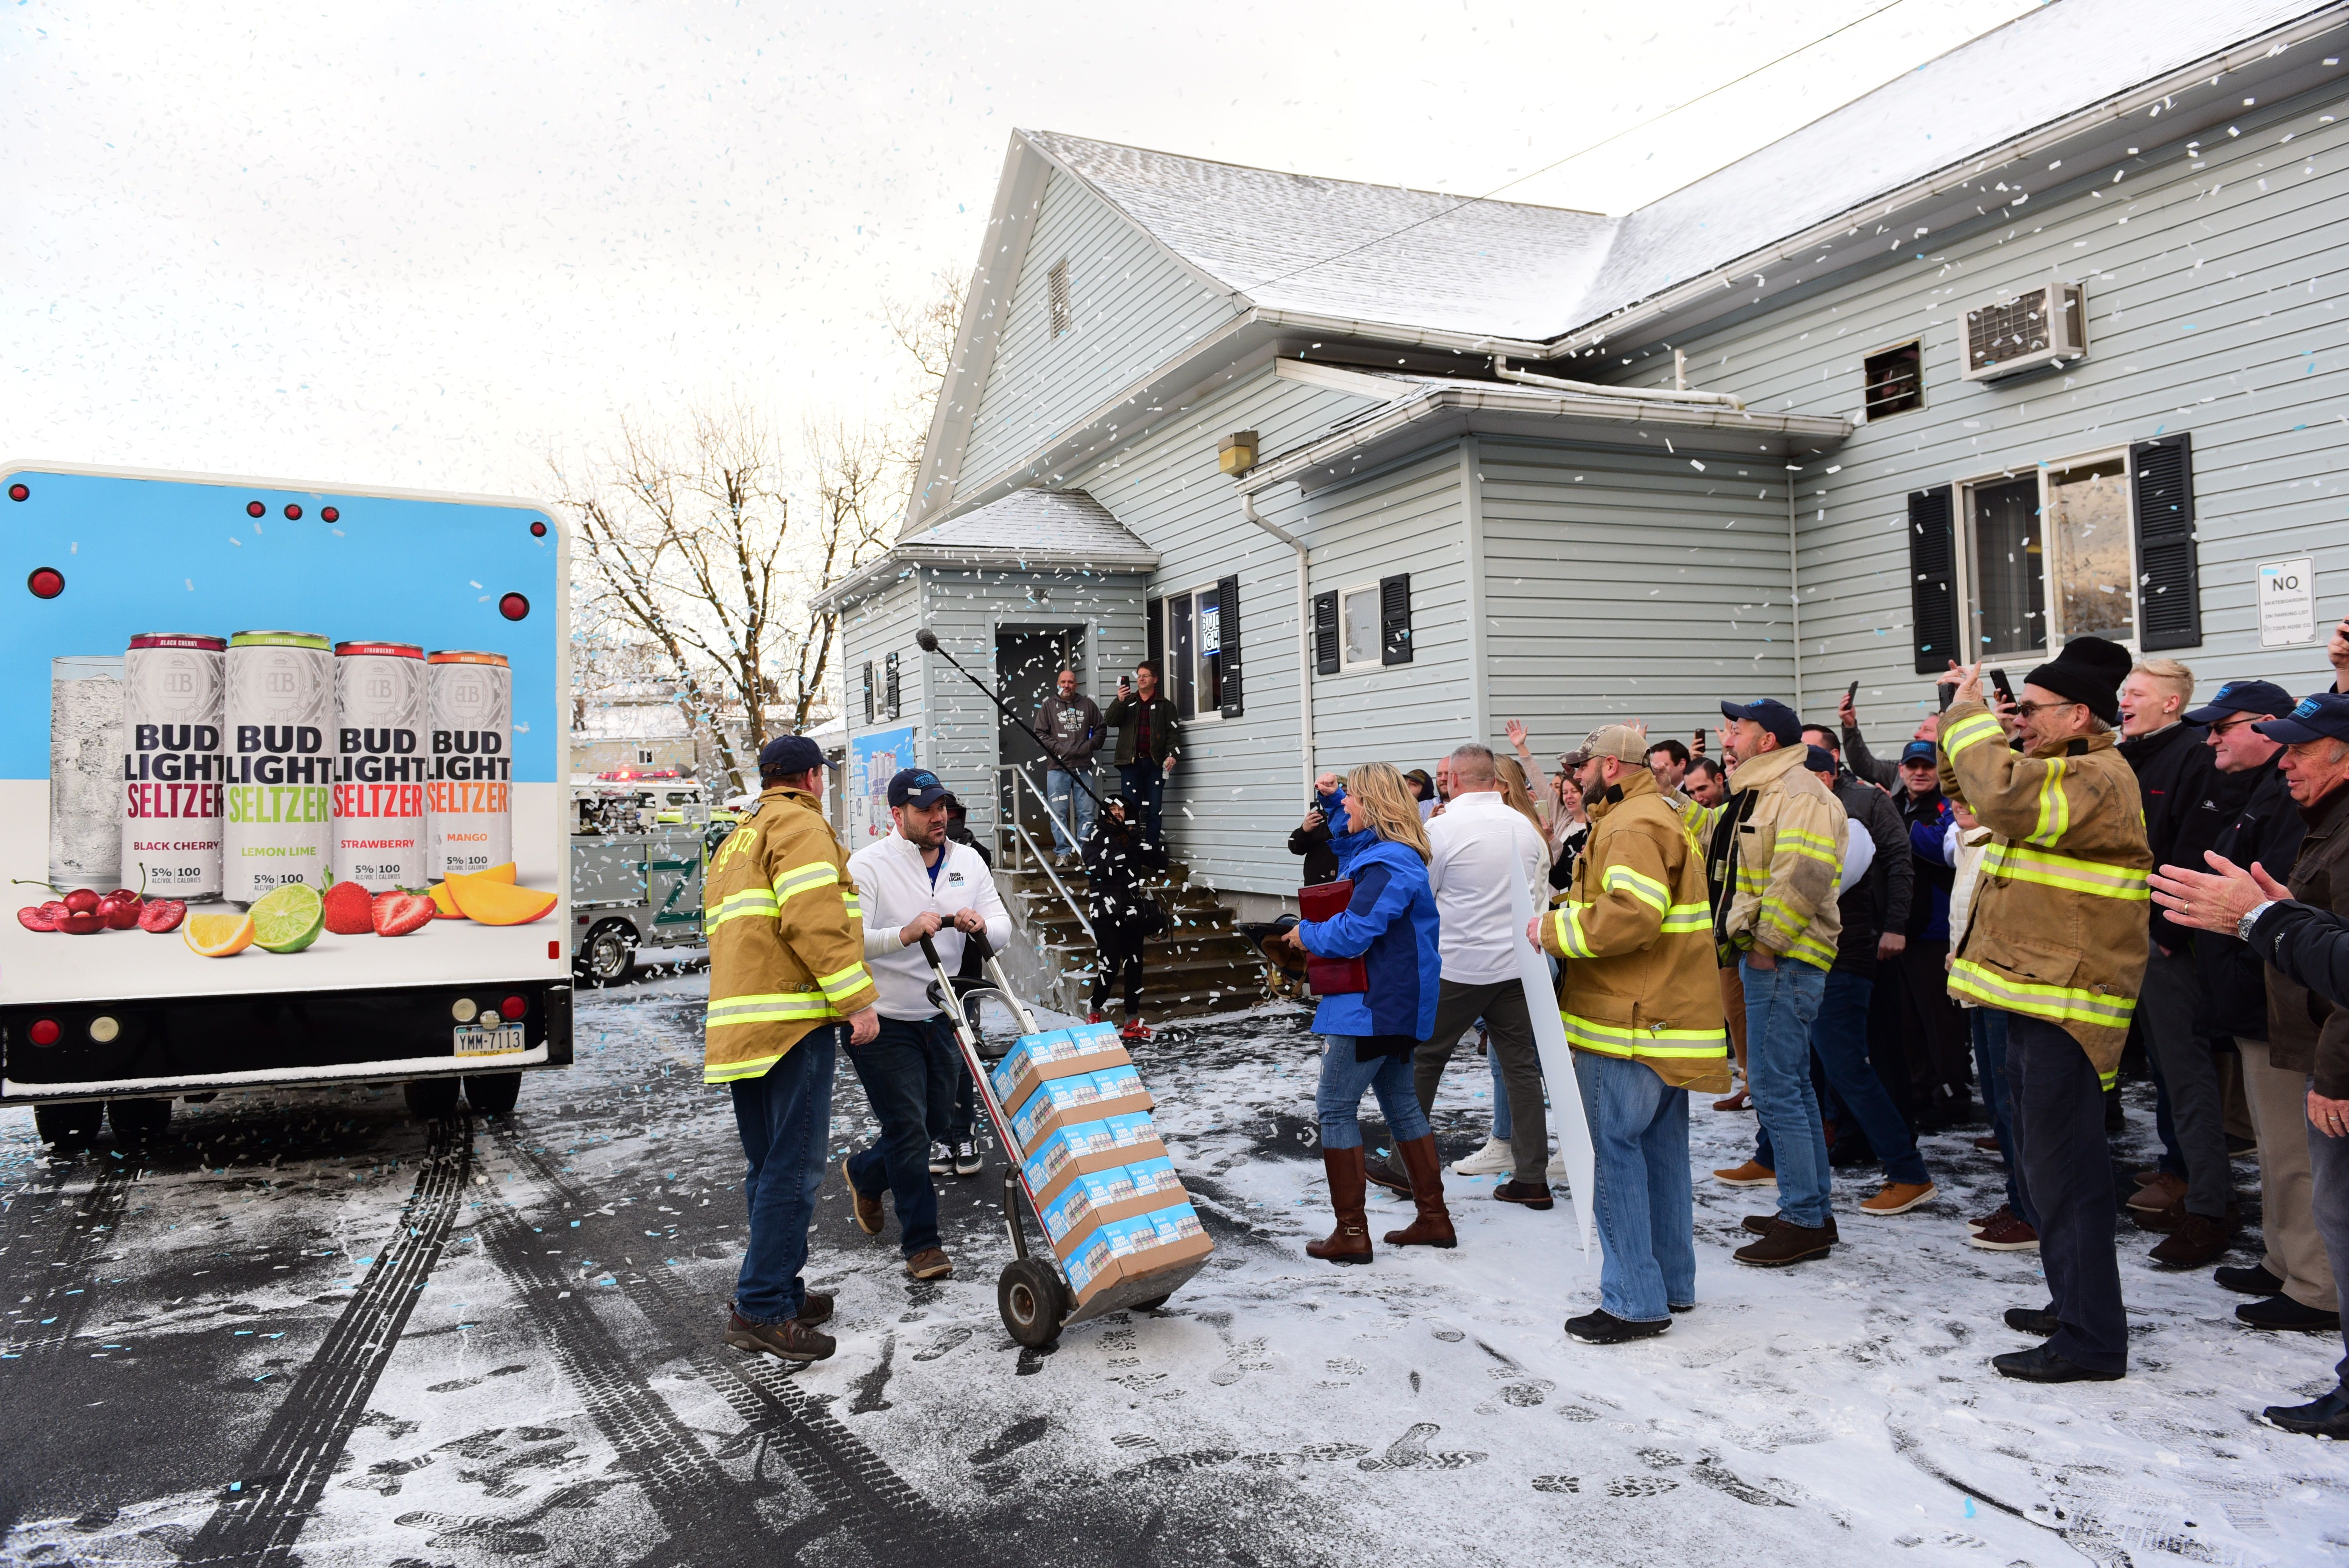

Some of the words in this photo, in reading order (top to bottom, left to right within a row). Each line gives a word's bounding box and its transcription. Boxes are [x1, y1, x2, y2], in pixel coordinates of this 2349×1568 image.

[2272, 576, 2299, 592] NO
[2264, 596, 2309, 606] SKATEBOARDING
[135, 724, 219, 752] BUD
[237, 725, 322, 753] BUD
[340, 728, 417, 754] BUD
[433, 730, 502, 754] BUD
[125, 753, 223, 781] LIGHT
[226, 755, 332, 784] LIGHT
[128, 783, 224, 818] SELTZER
[229, 786, 329, 823] SELTZER
[333, 784, 422, 817] SELTZER
[427, 782, 508, 813] SELTZER
[134, 842, 170, 850] BLACK
[173, 841, 219, 850] CHERRY
[341, 839, 415, 848] STRAWBERRY
[447, 833, 488, 842] MANGO
[242, 847, 285, 857] LEMON
[289, 846, 316, 856] LIME
[468, 856, 488, 864] 100
[151, 868, 172, 877] 5%
[178, 867, 201, 877] 100
[355, 865, 374, 873] 5%
[379, 864, 400, 873] 100
[254, 875, 274, 884] 5%
[280, 874, 303, 883] 100
[460, 1031, 520, 1051] YMM-7113
[996, 1072, 1006, 1087] BUD
[997, 1076, 1011, 1093] LIGHT
[1016, 1117, 1027, 1131] BUD
[1018, 1121, 1032, 1140] LIGHT
[1028, 1162, 1040, 1178] BUD
[1029, 1167, 1045, 1188] LIGHT
[1137, 1178, 1153, 1187] LIGHT
[1091, 1189, 1108, 1199] LIGHT
[1048, 1210, 1060, 1226] BUD
[1049, 1215, 1065, 1235] LIGHT
[1112, 1235, 1125, 1243] BUD
[1158, 1226, 1175, 1236] LIGHT
[1112, 1239, 1130, 1249] LIGHT
[1068, 1260, 1081, 1275] BUD
[1070, 1265, 1086, 1285] LIGHT
